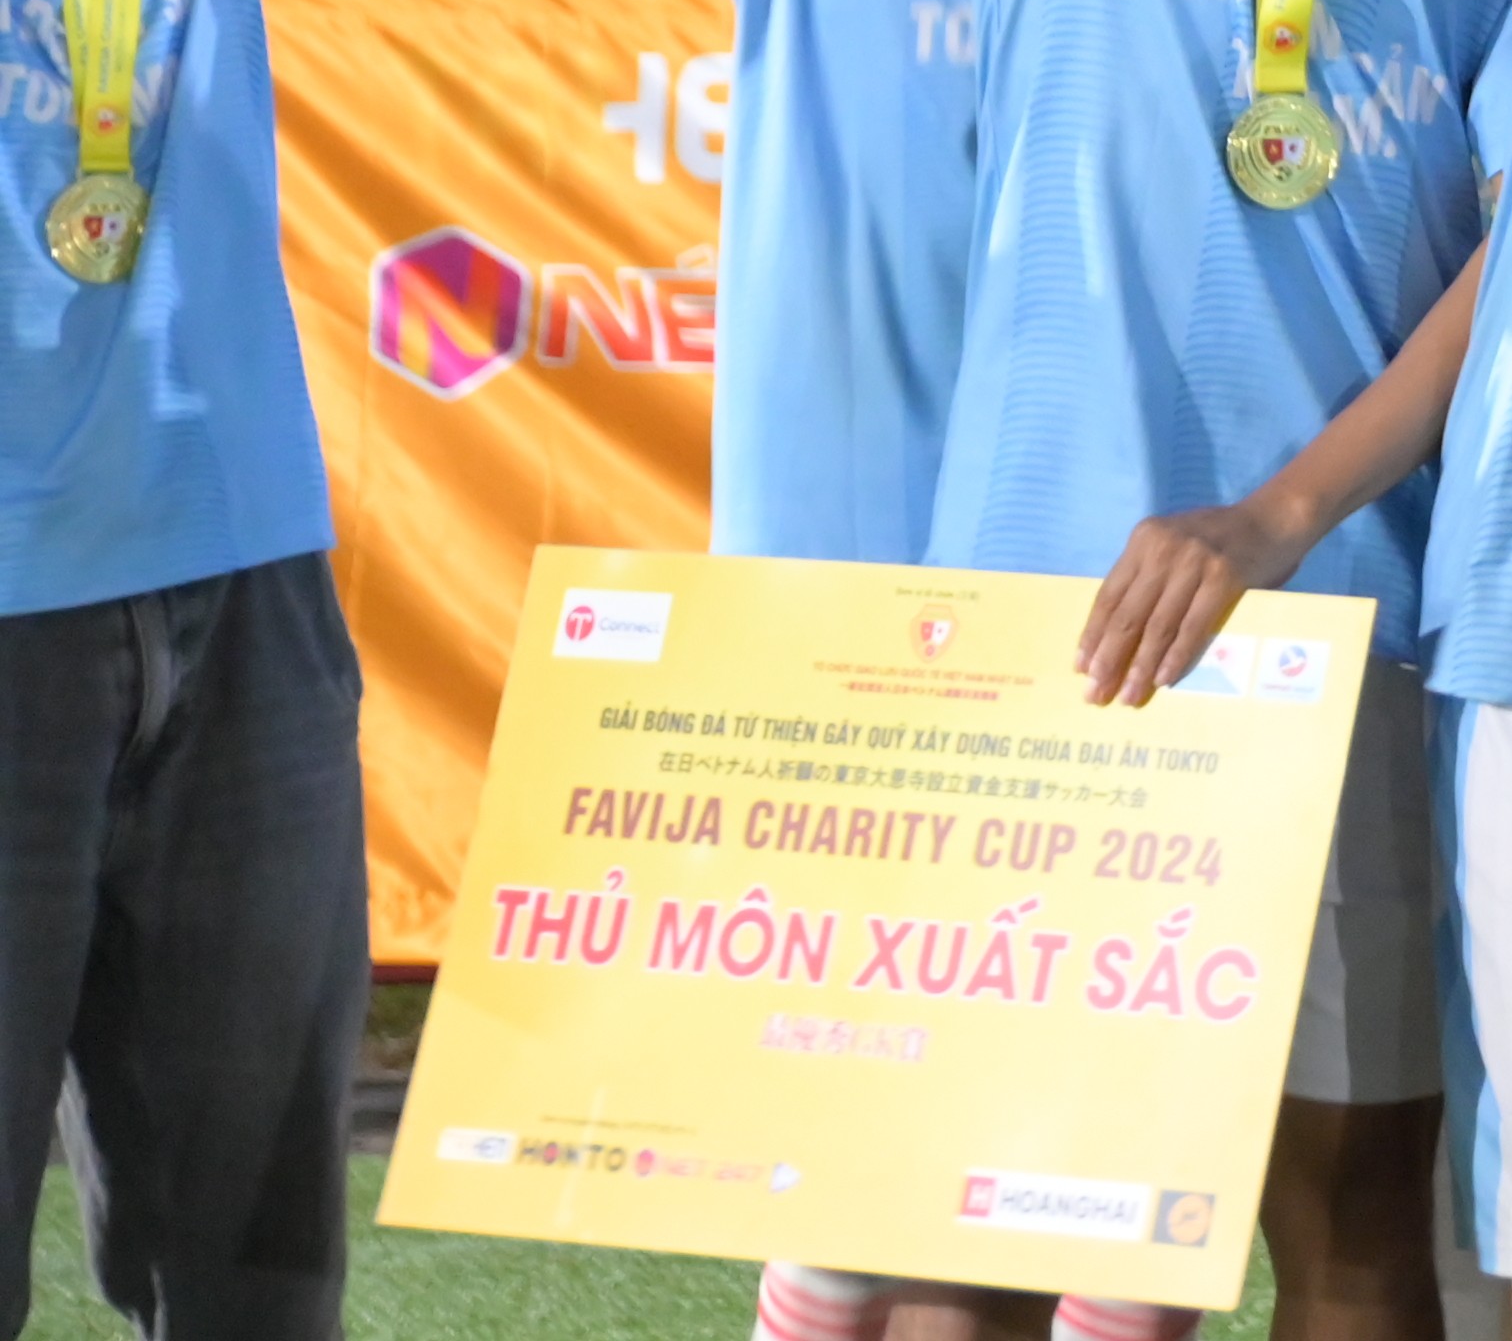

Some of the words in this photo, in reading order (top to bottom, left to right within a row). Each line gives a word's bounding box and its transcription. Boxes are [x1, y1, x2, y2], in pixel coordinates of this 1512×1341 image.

[600, 698, 637, 733] GIẢI
[643, 707, 695, 735] BÓNG
[762, 714, 817, 750] THIỆN
[1156, 747, 1220, 775] TOKYO
[562, 785, 724, 846] FAVIJA
[743, 799, 958, 864] CHARITY
[972, 814, 1080, 879] CUP
[1094, 828, 1225, 887] 2024
[490, 869, 632, 964] THỦ
[646, 887, 835, 985] MÔN
[851, 897, 1069, 1003] XUẤT
[1085, 908, 1258, 1022] SẮC
